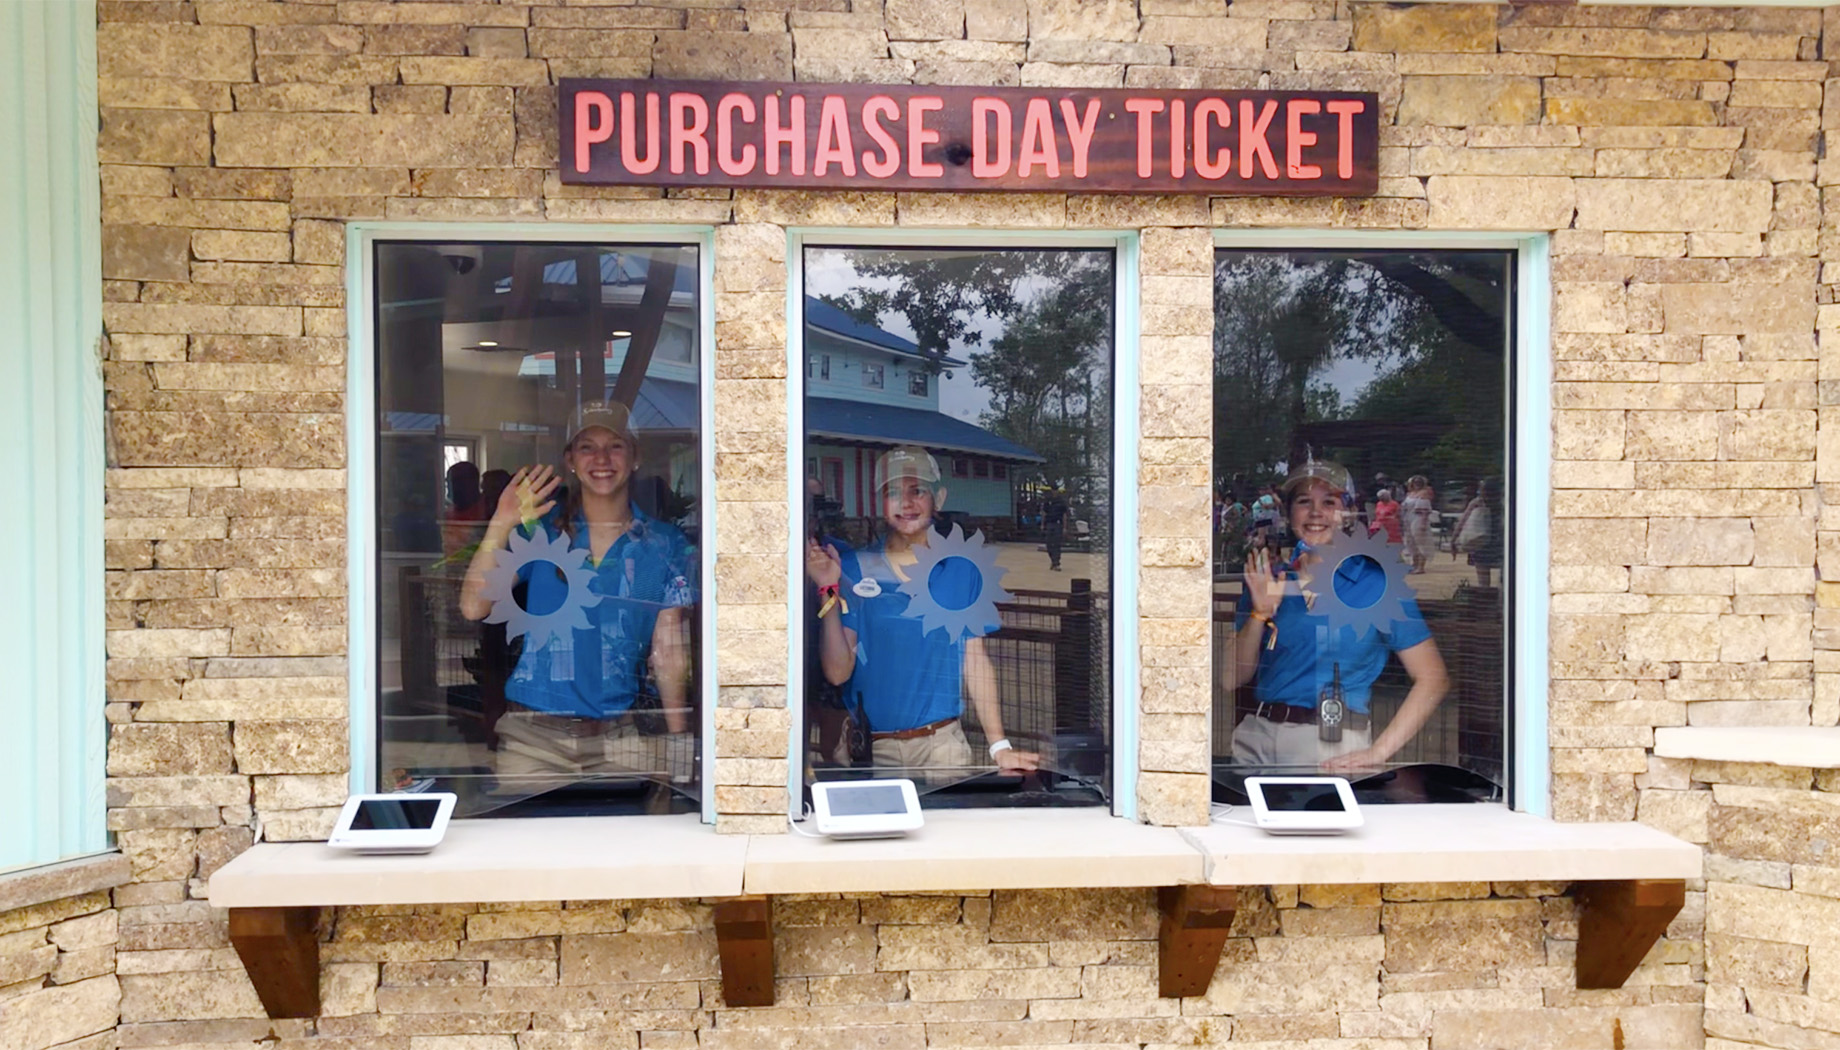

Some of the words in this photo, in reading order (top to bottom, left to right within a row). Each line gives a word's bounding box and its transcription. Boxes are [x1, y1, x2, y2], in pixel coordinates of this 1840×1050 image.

[575, 91, 945, 178] PURCHASE
[971, 97, 1102, 179] DAY
[1124, 98, 1365, 180] TICKET
